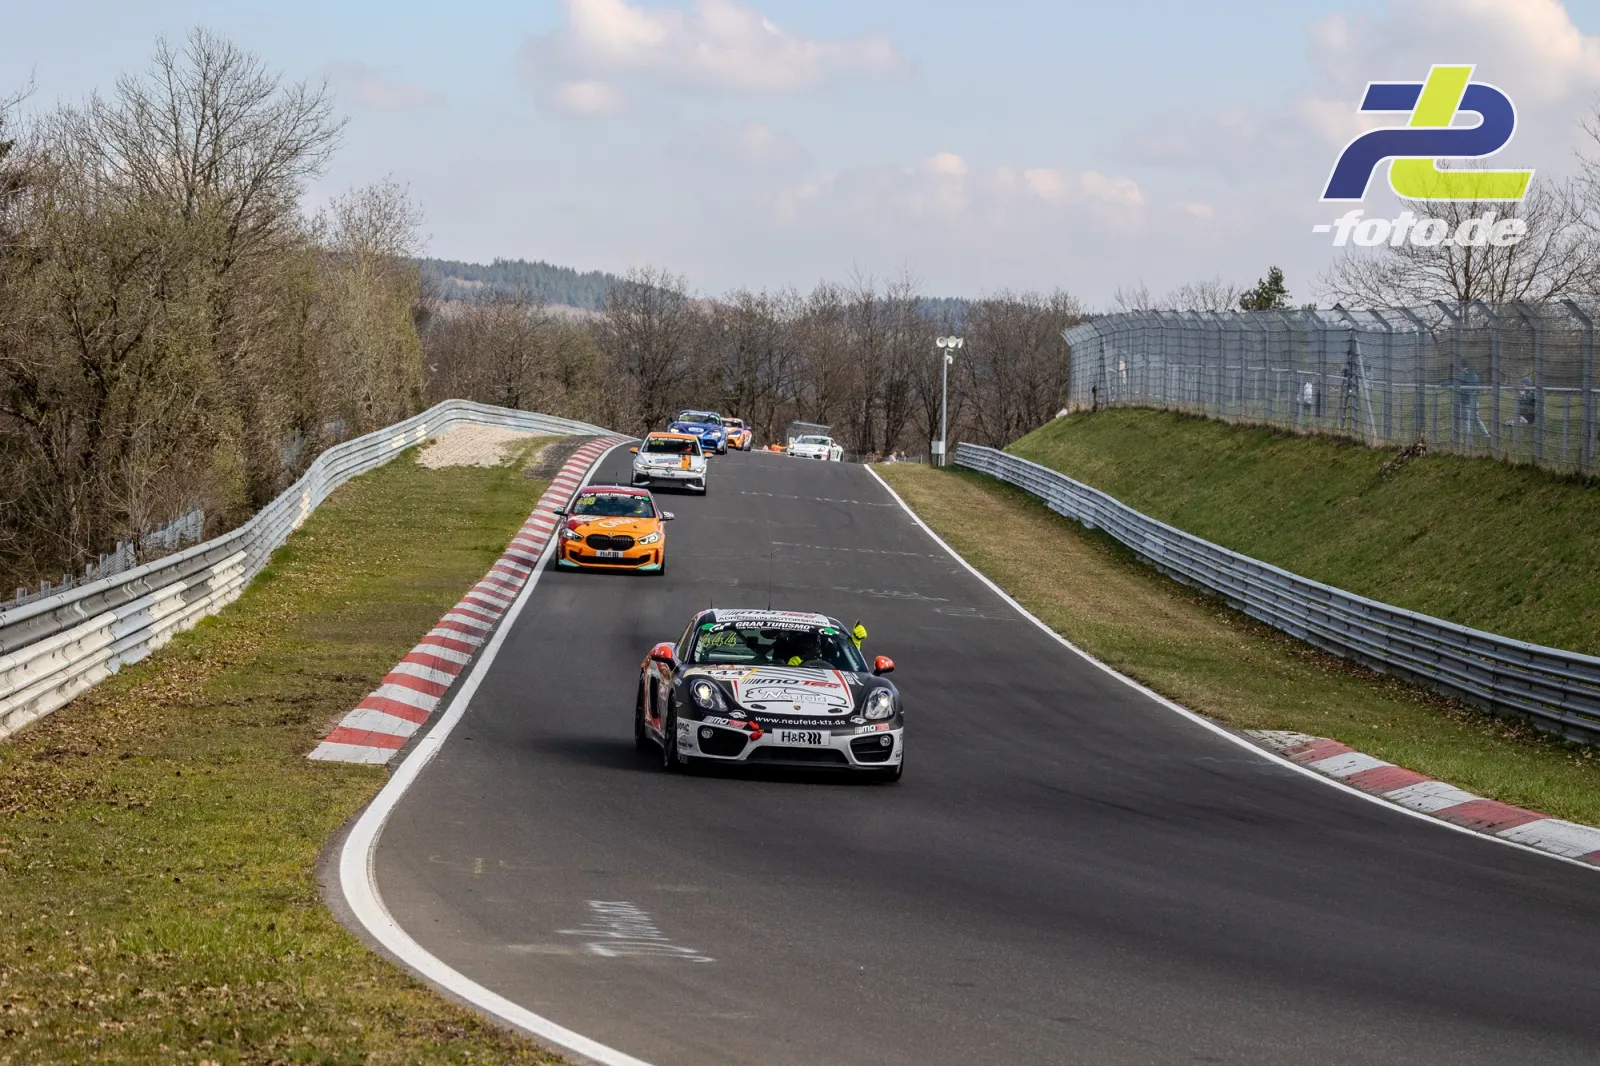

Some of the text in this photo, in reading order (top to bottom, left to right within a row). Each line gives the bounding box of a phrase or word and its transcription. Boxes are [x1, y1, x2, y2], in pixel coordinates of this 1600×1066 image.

[766, 621, 811, 630] TURISMO
[701, 632, 737, 647] 444
[763, 690, 827, 703] Neufeld
[755, 715, 846, 726] www.neufeld-kfz.de
